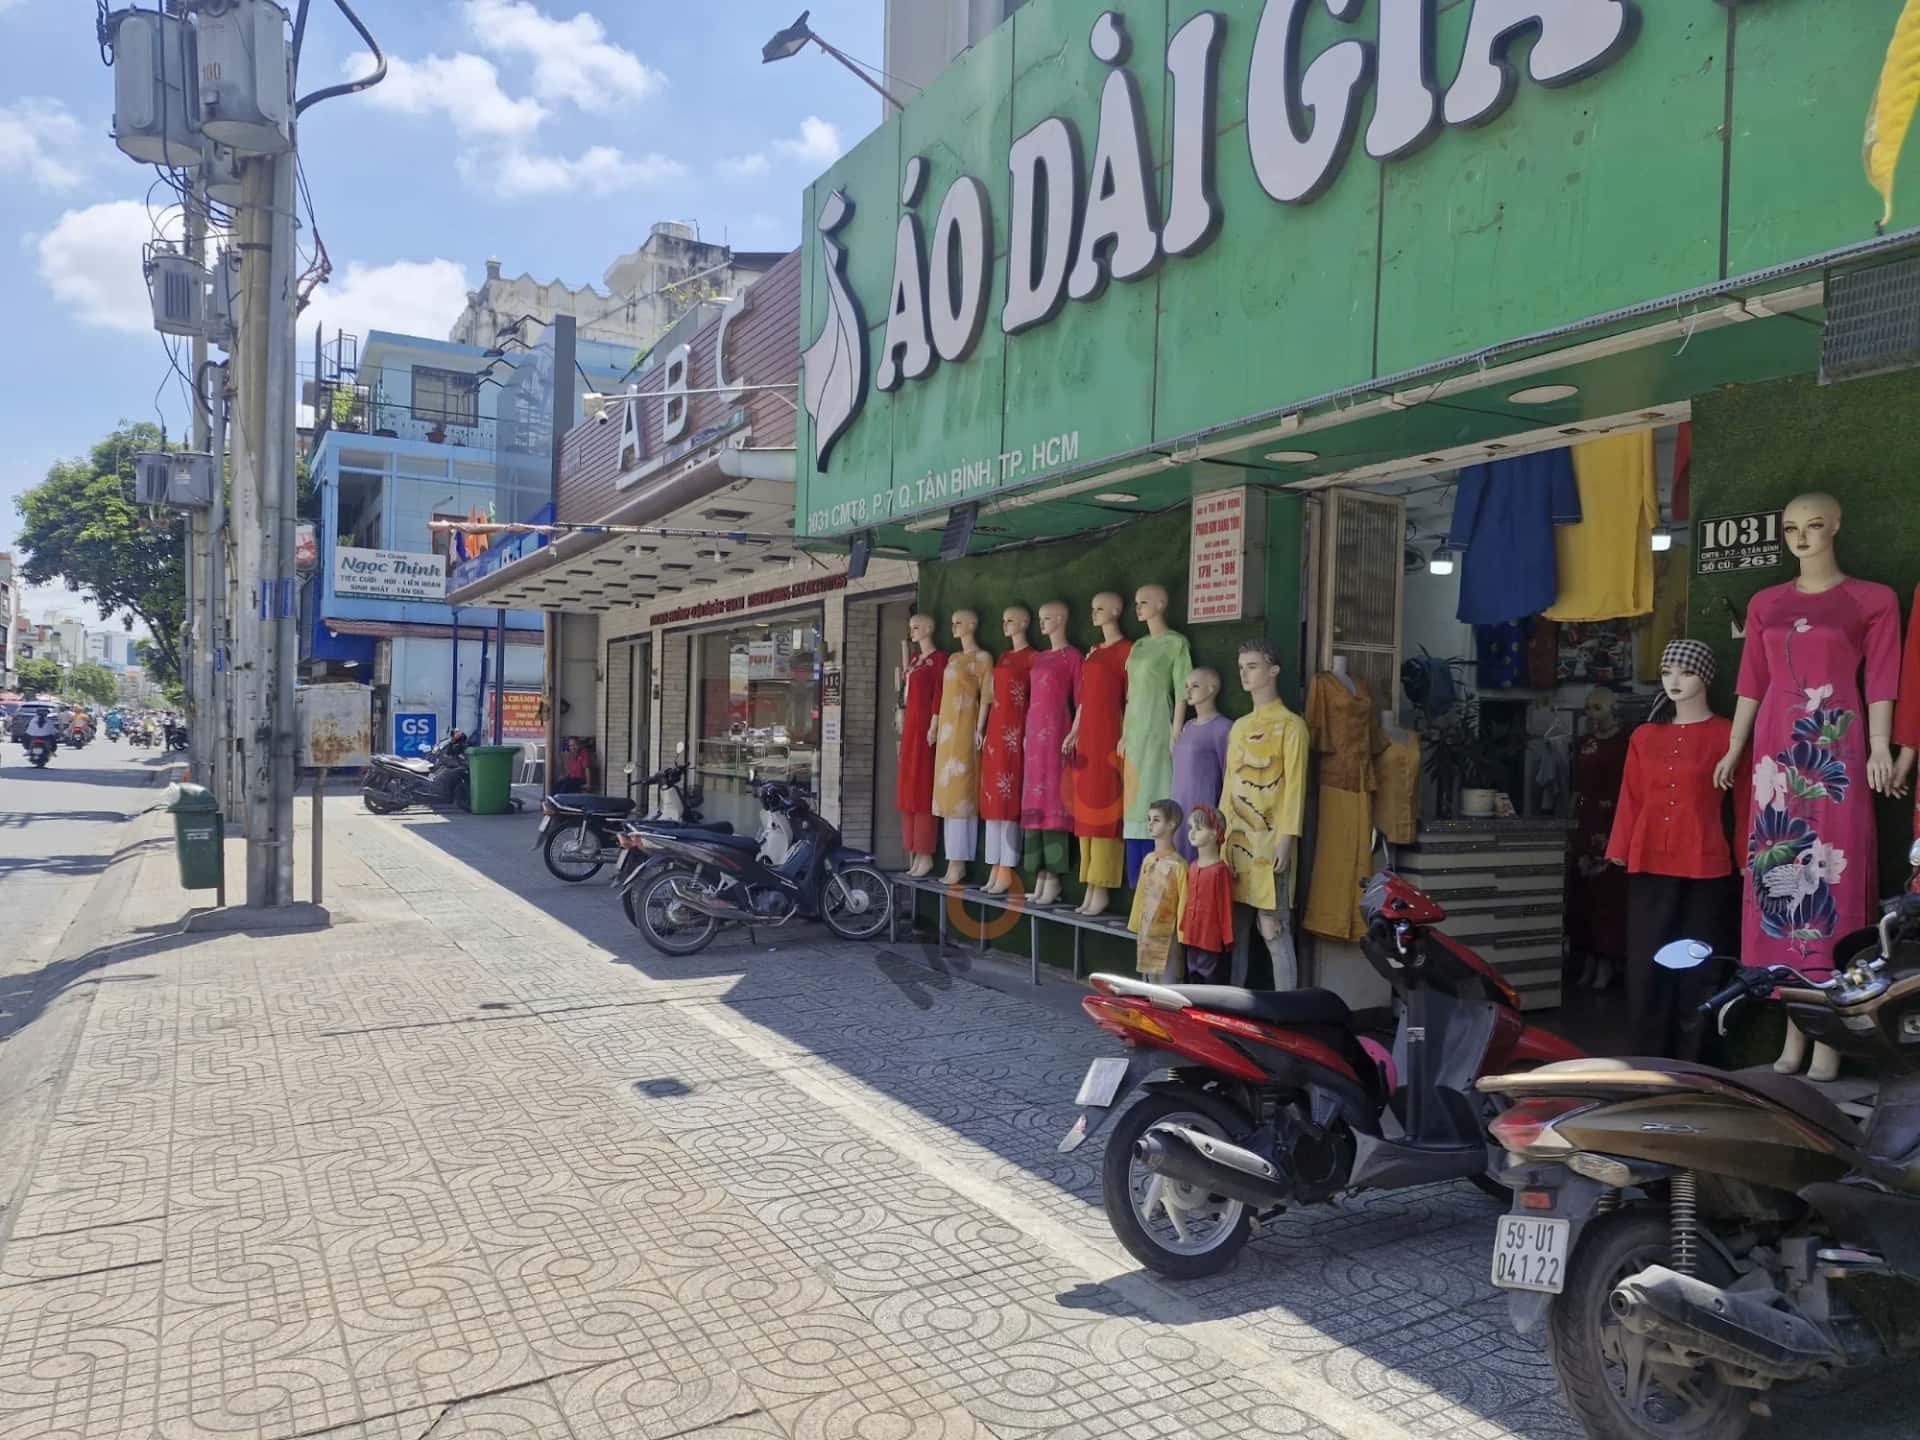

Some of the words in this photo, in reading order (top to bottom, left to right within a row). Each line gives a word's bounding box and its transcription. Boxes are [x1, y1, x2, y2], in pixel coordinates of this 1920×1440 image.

[876, 155, 991, 393] ÁO
[1001, 10, 1226, 335] DÀI
[617, 287, 745, 474] ABC
[916, 470, 947, 502] TÂN
[951, 459, 996, 497] BÌNH,
[999, 451, 1026, 480] TP.
[1032, 431, 1079, 471] HCM
[1703, 513, 1777, 549] 1031
[341, 556, 388, 574] Ngọc
[394, 560, 441, 577] Thịnh
[1739, 554, 1777, 568] 263
[402, 718, 430, 735] GS
[1506, 1222, 1555, 1253] 59-U1
[1497, 1252, 1560, 1286] 041.22
